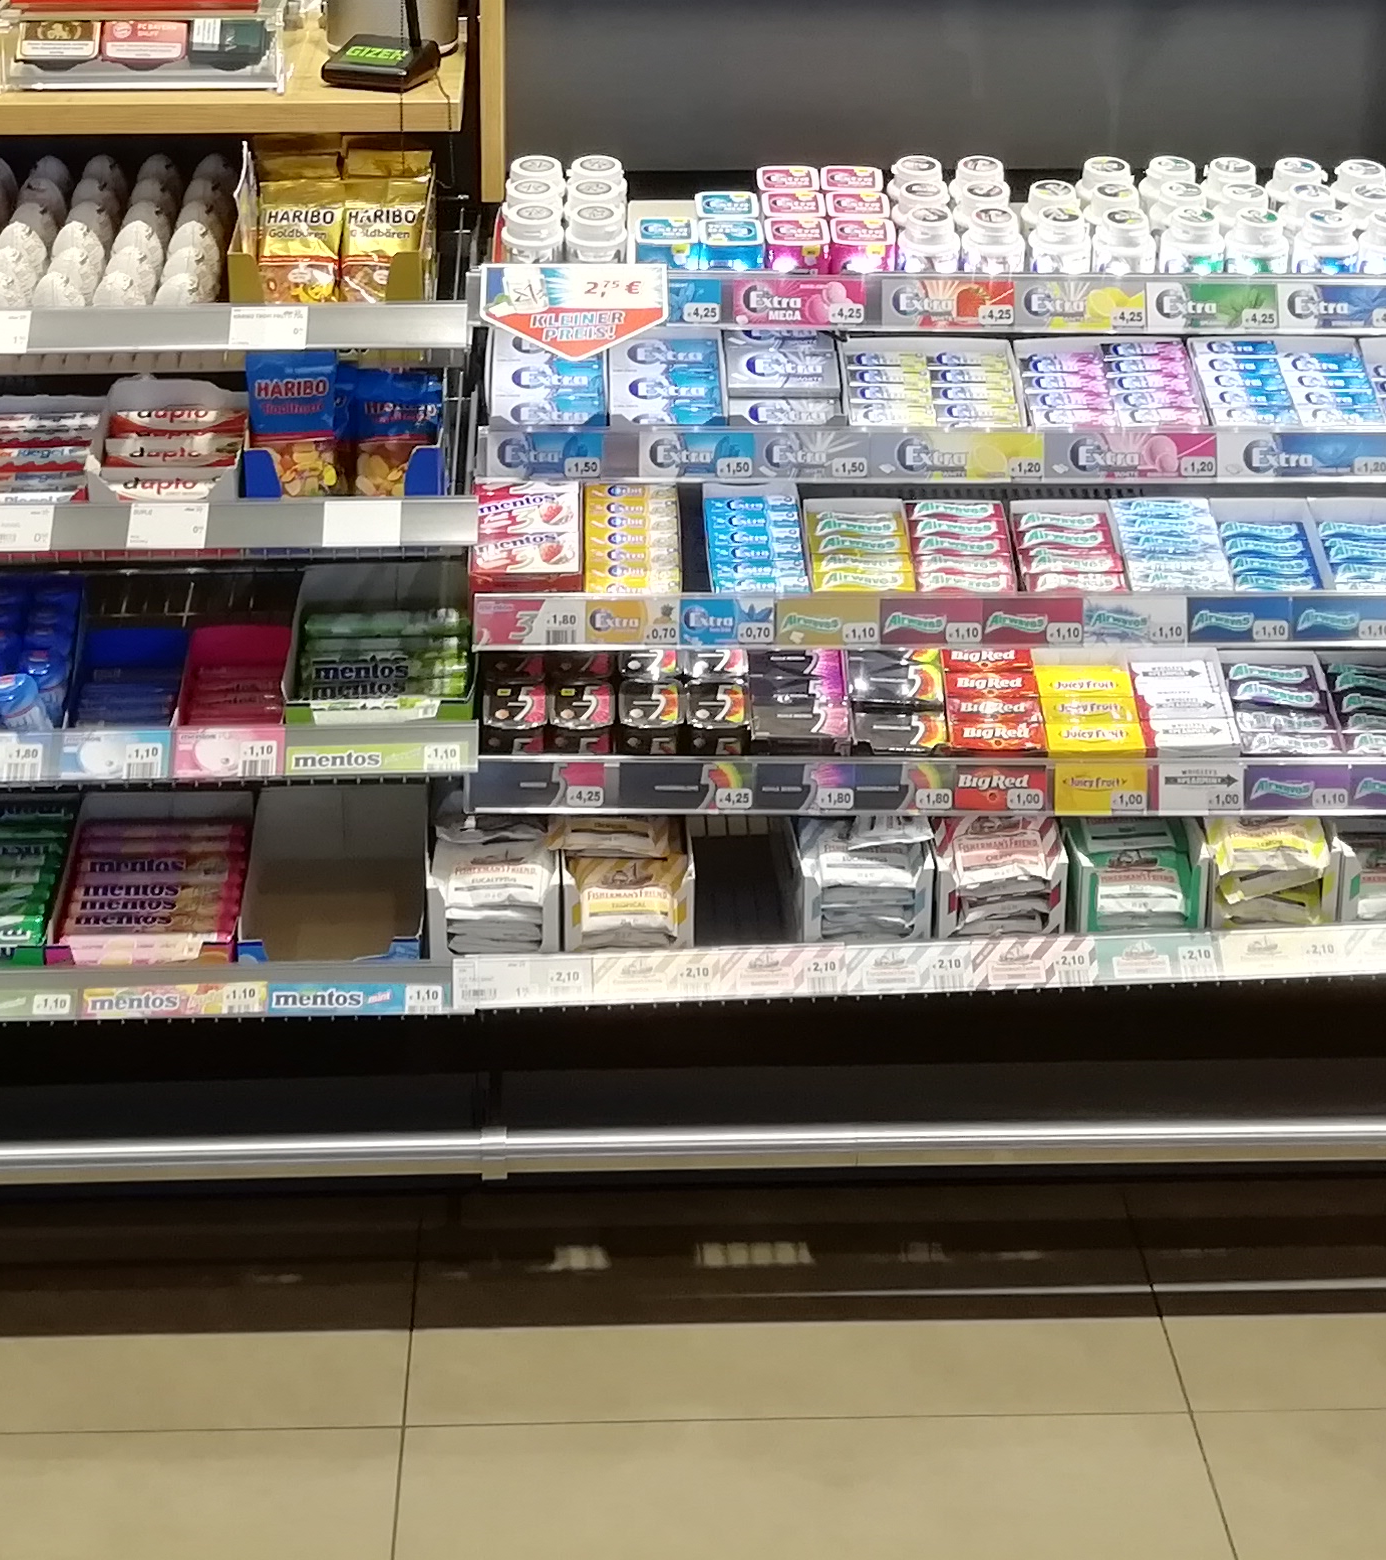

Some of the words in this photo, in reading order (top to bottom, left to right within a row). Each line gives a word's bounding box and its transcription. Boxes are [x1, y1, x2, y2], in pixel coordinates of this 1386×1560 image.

[267, 210, 335, 224] HARIBO
[749, 290, 802, 309] Extra
[1294, 297, 1348, 315] Extra
[530, 312, 625, 328] KLEINER
[768, 309, 801, 321] MEGA
[542, 327, 616, 342] PREIS!
[256, 379, 328, 399] HARIBO
[1077, 447, 1139, 465] Extra
[820, 521, 896, 535] Airwaves
[314, 665, 409, 681] mentos
[957, 676, 1022, 689] BigRed
[292, 752, 381, 769] mentos
[958, 774, 1029, 789] BigRed
[273, 991, 363, 1008] mentos
